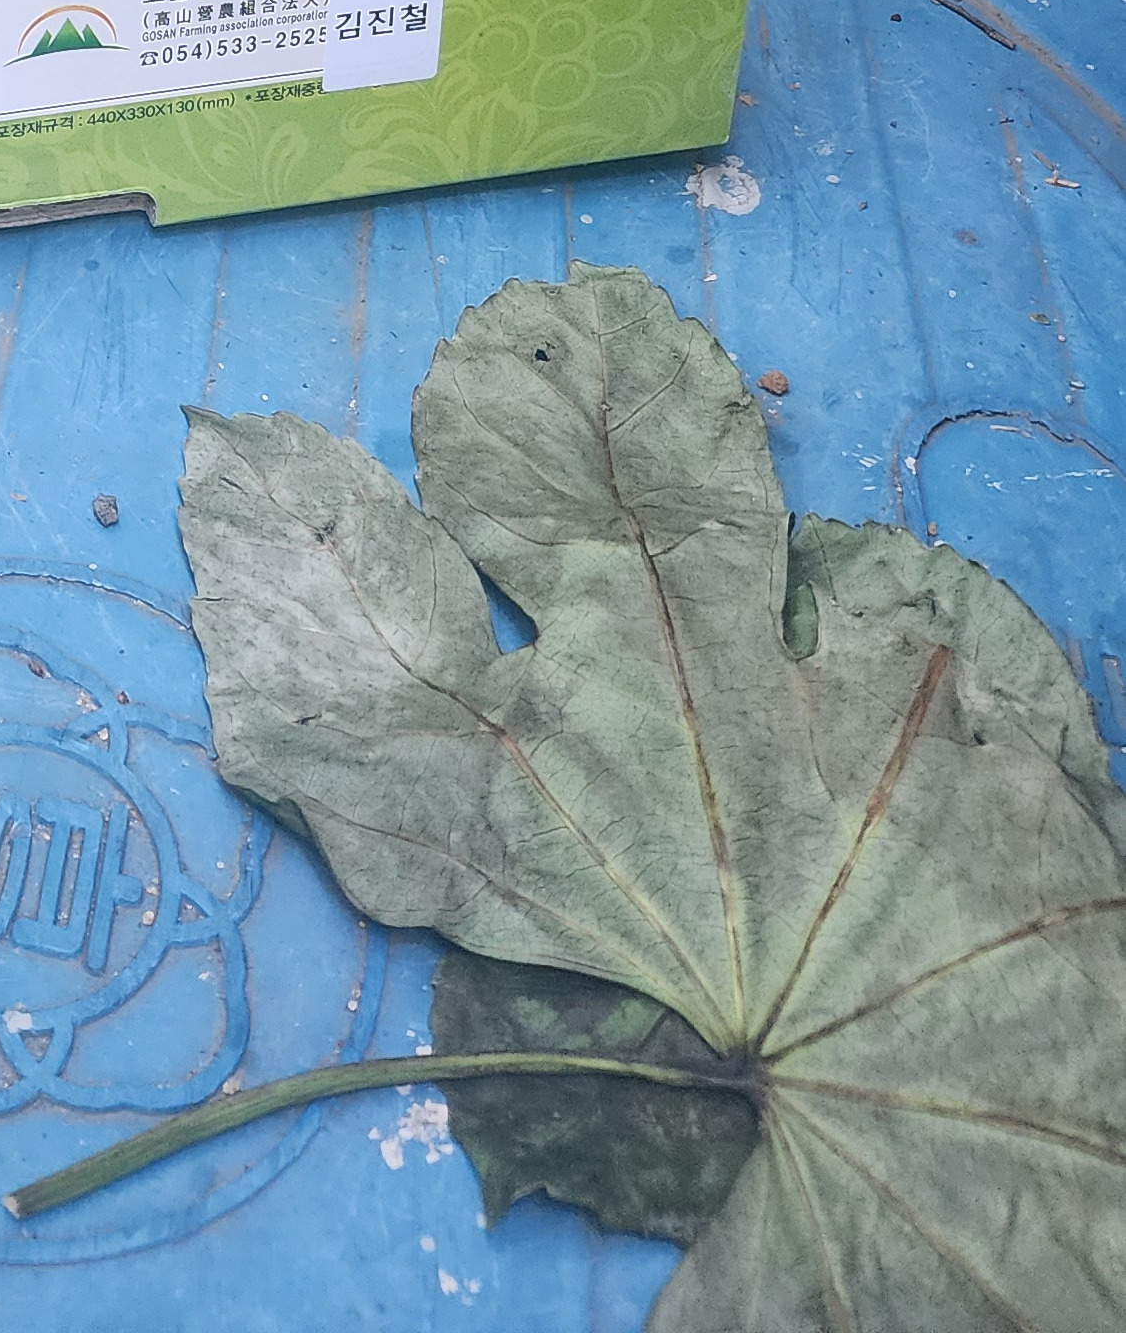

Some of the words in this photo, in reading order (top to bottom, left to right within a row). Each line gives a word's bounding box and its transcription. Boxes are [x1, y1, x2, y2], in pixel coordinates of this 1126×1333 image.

[142, 27, 176, 43] GOSAN
[179, 23, 217, 38] Farming
[219, 17, 273, 33] association
[335, 2, 428, 41] 김진철
